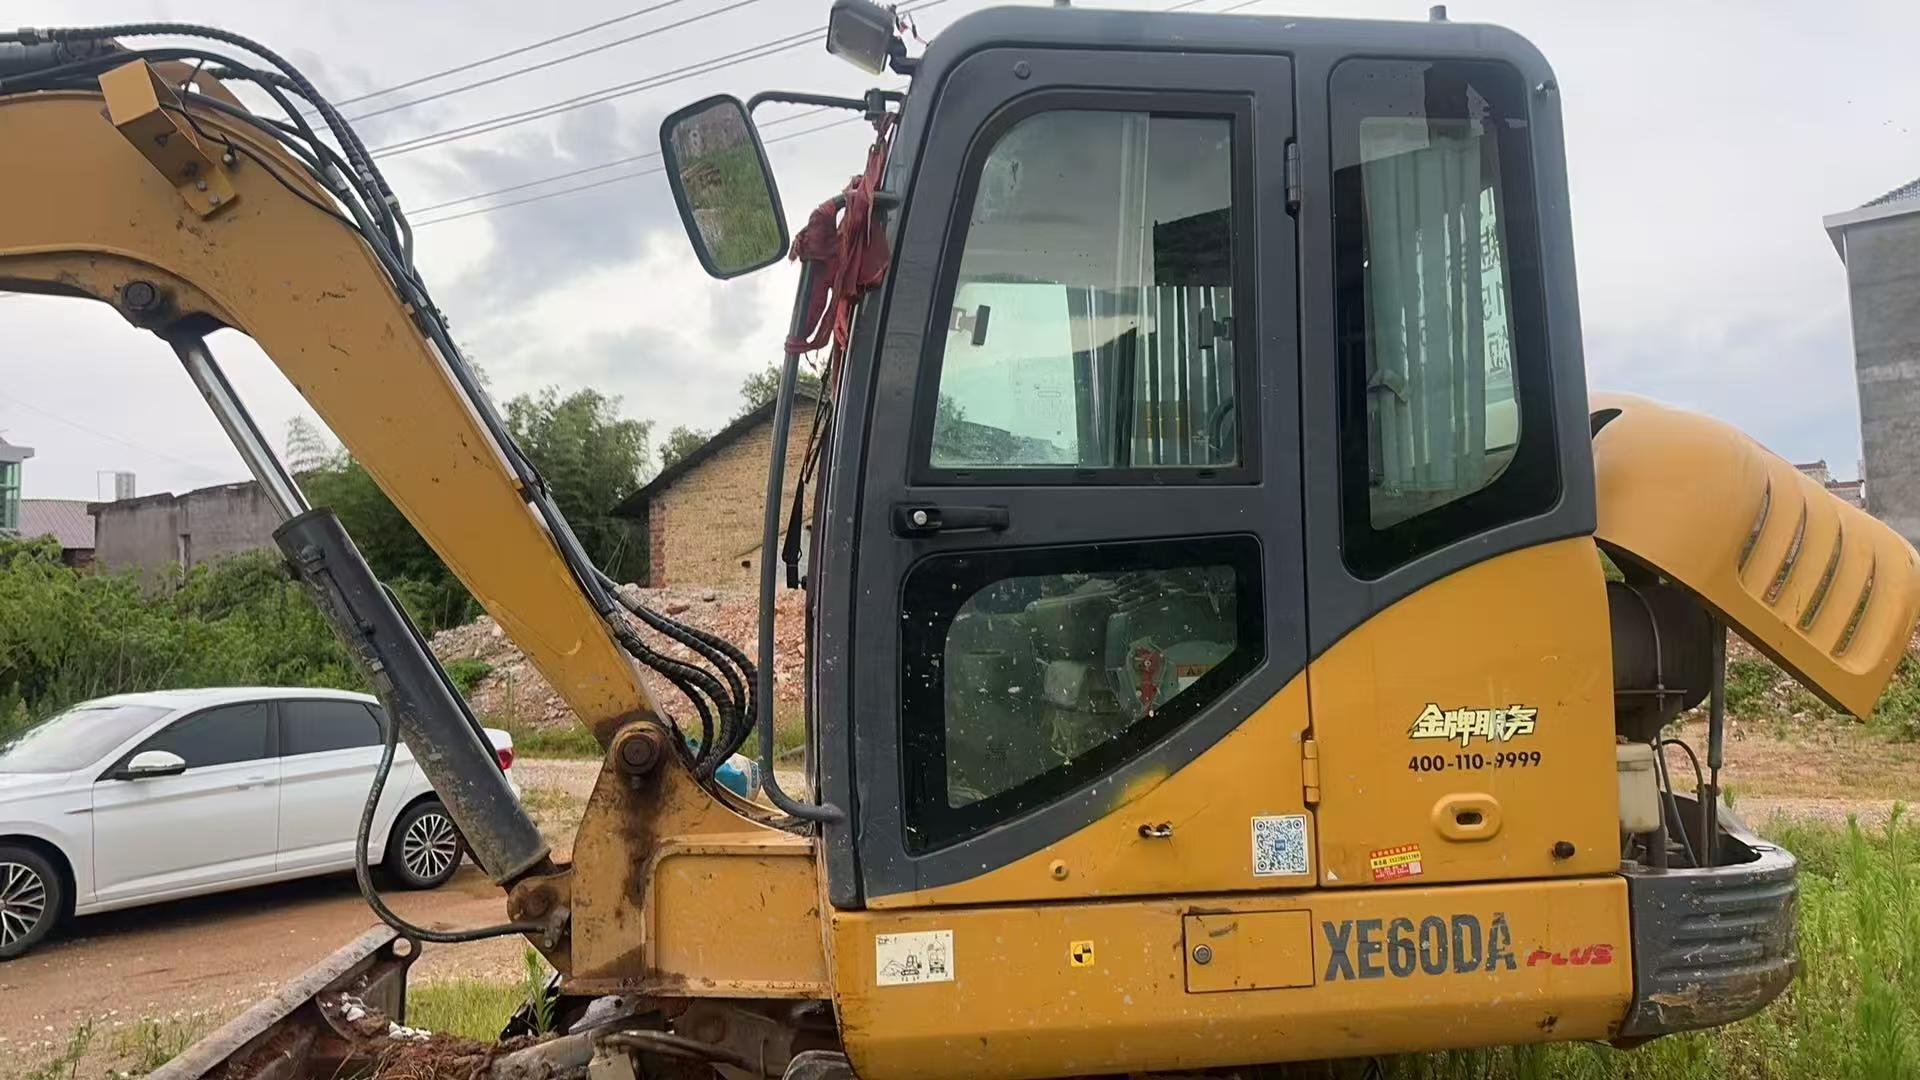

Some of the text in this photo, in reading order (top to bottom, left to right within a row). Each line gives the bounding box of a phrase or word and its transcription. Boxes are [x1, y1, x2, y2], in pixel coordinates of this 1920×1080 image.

[1408, 703, 1538, 748] 金牌服务
[1408, 751, 1541, 772] 400-110-9999
[1321, 912, 1517, 981] XE60DA
